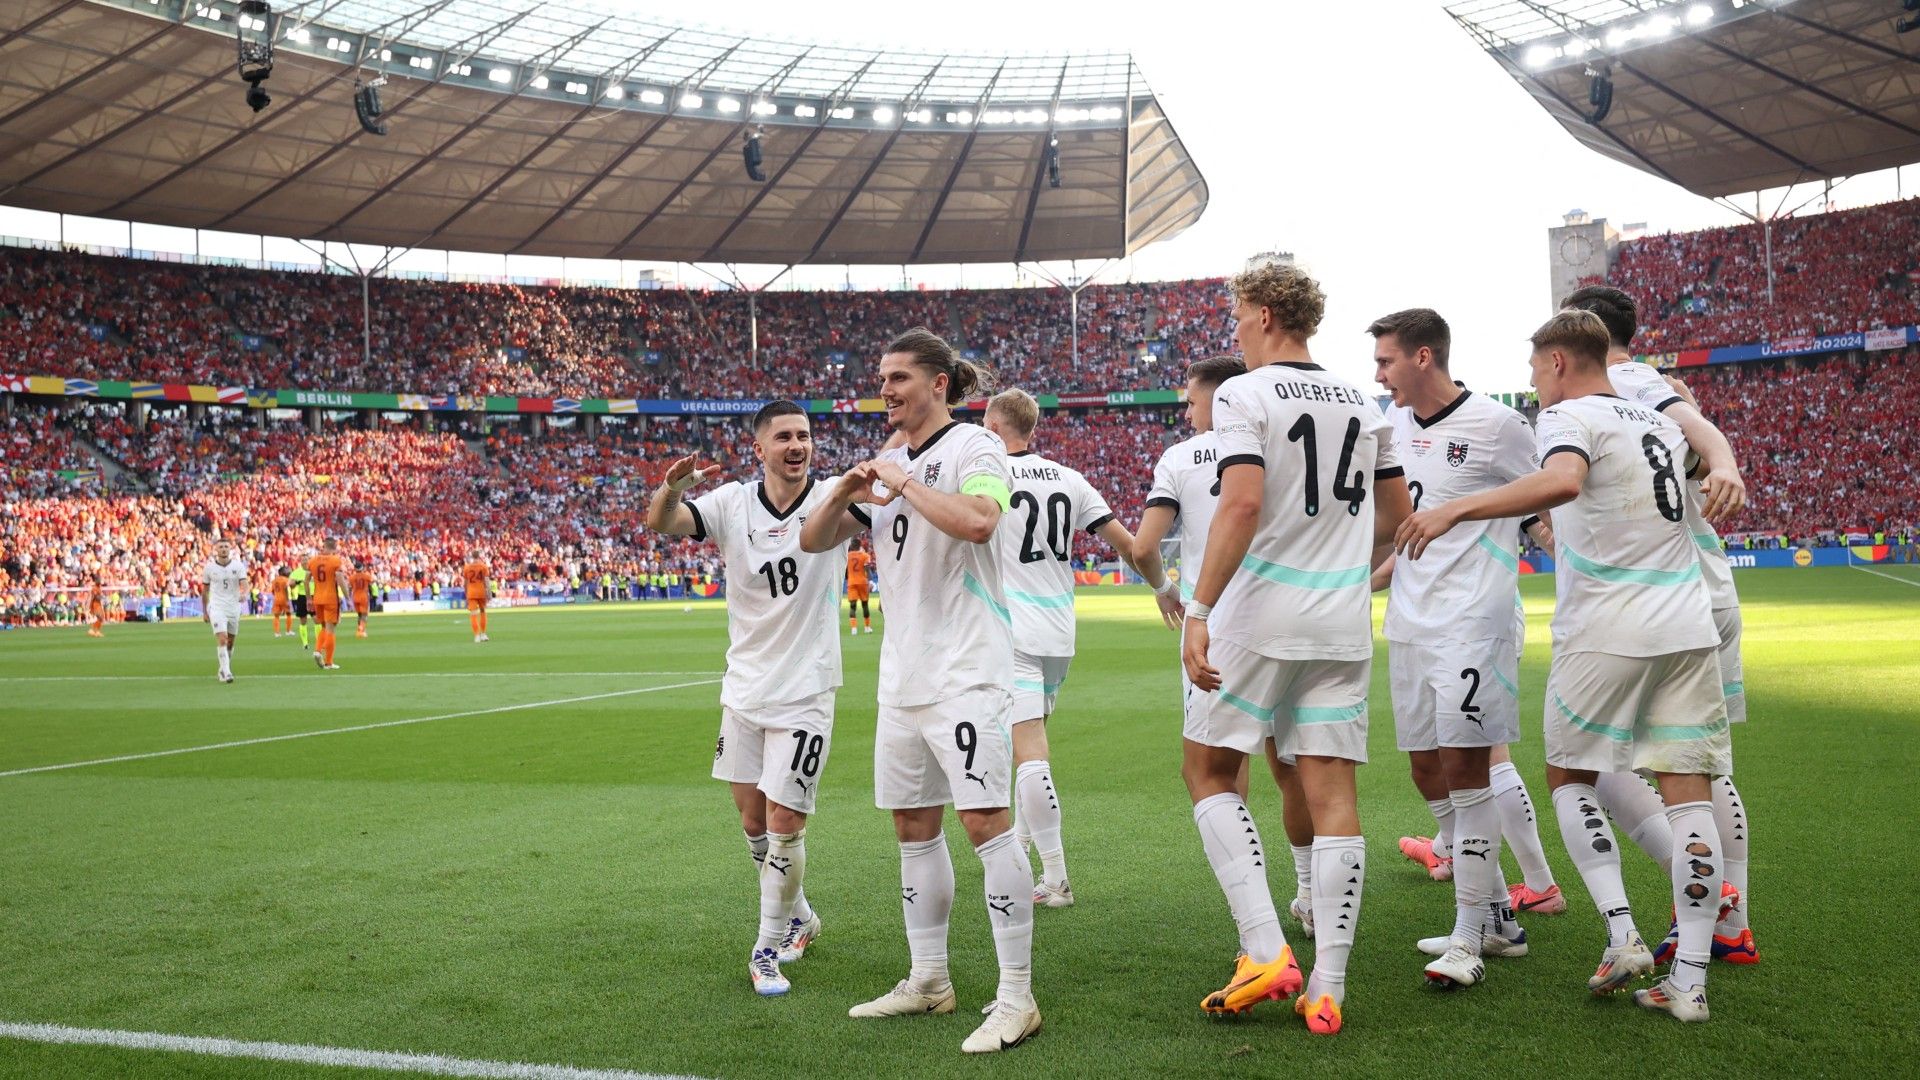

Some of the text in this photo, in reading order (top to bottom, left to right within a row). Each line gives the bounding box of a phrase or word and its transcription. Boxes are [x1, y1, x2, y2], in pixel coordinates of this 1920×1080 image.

[296, 392, 352, 405] BERLIN
[1107, 393, 1134, 404] LIN
[1274, 382, 1364, 406] QUERFELD
[1011, 466, 1061, 481] LAIMER
[1287, 413, 1366, 517] 14
[1641, 433, 1684, 522] 8
[892, 514, 908, 561] 9
[1010, 490, 1071, 564] 20
[852, 558, 860, 571] 2
[1727, 554, 1756, 567] am
[223, 579, 229, 590] 5
[317, 564, 327, 582] 6
[470, 569, 484, 583] 24
[759, 557, 799, 598] 18
[1460, 667, 1480, 712] 2
[790, 729, 824, 777] 18
[955, 721, 978, 771] 9
